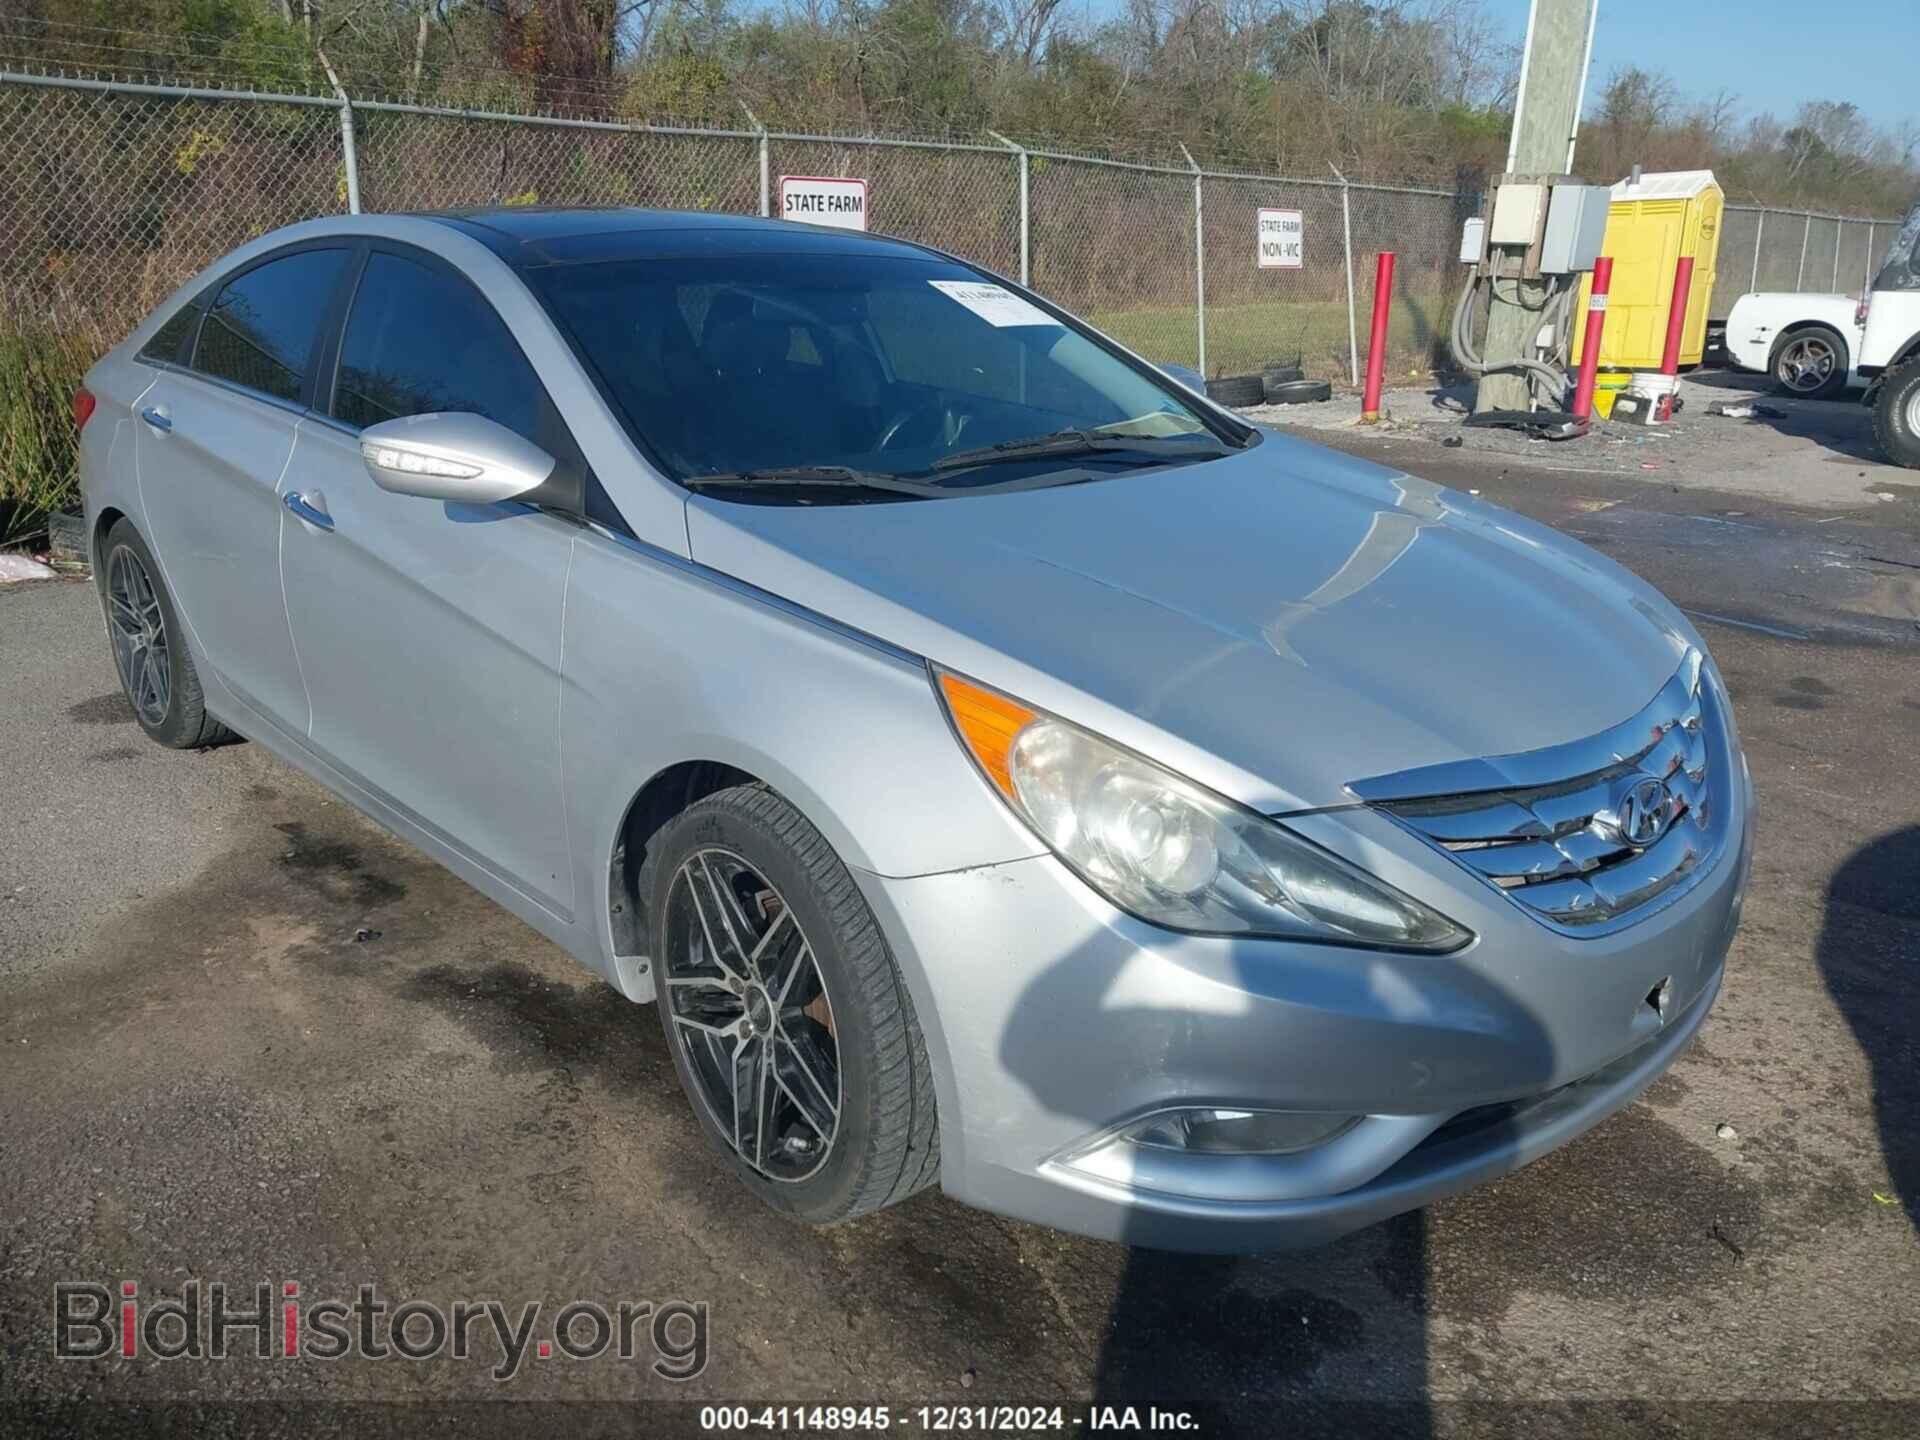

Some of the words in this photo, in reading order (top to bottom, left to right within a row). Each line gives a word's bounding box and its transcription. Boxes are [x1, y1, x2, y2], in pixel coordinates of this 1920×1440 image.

[785, 193, 825, 212] STATE
[827, 194, 863, 213] FARM
[1261, 219, 1281, 232] STATE
[1282, 220, 1300, 232] FARM
[1262, 242, 1299, 257] NON-VIC
